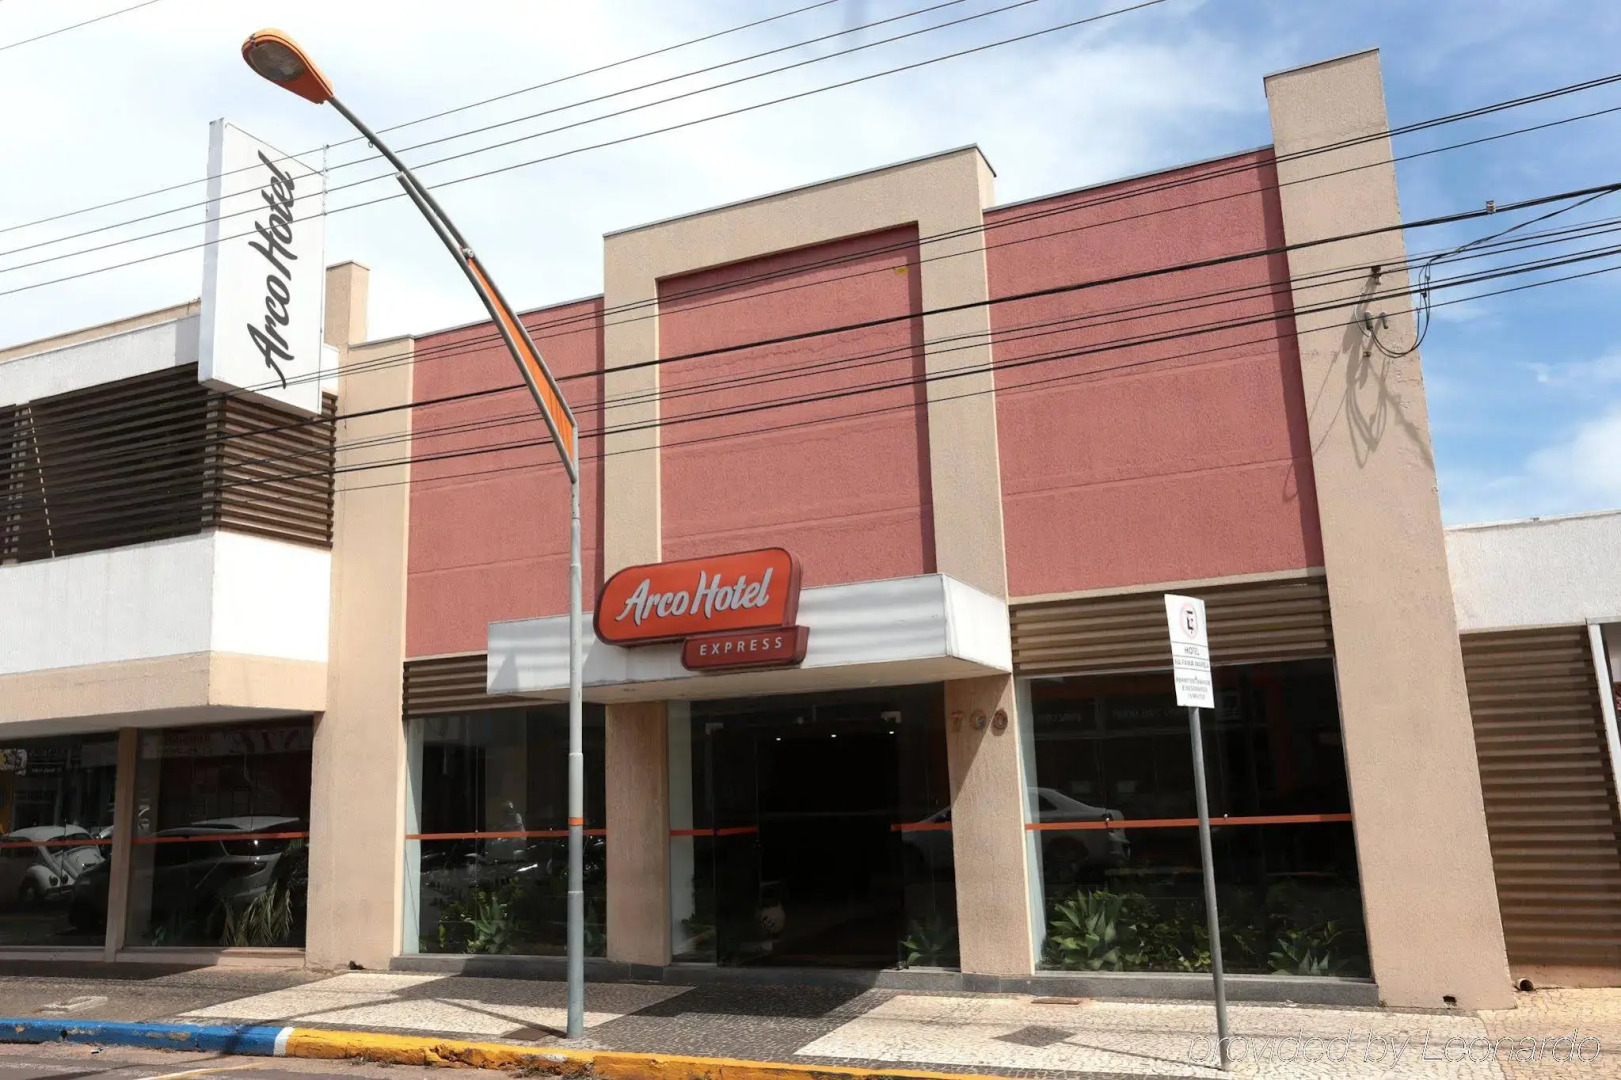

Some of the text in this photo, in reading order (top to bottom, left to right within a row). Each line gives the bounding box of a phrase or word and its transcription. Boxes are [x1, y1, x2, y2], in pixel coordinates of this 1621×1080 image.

[246, 148, 298, 390] Arco Hotel
[615, 567, 774, 626] Arco Hotel
[699, 636, 783, 656] EXPRESS
